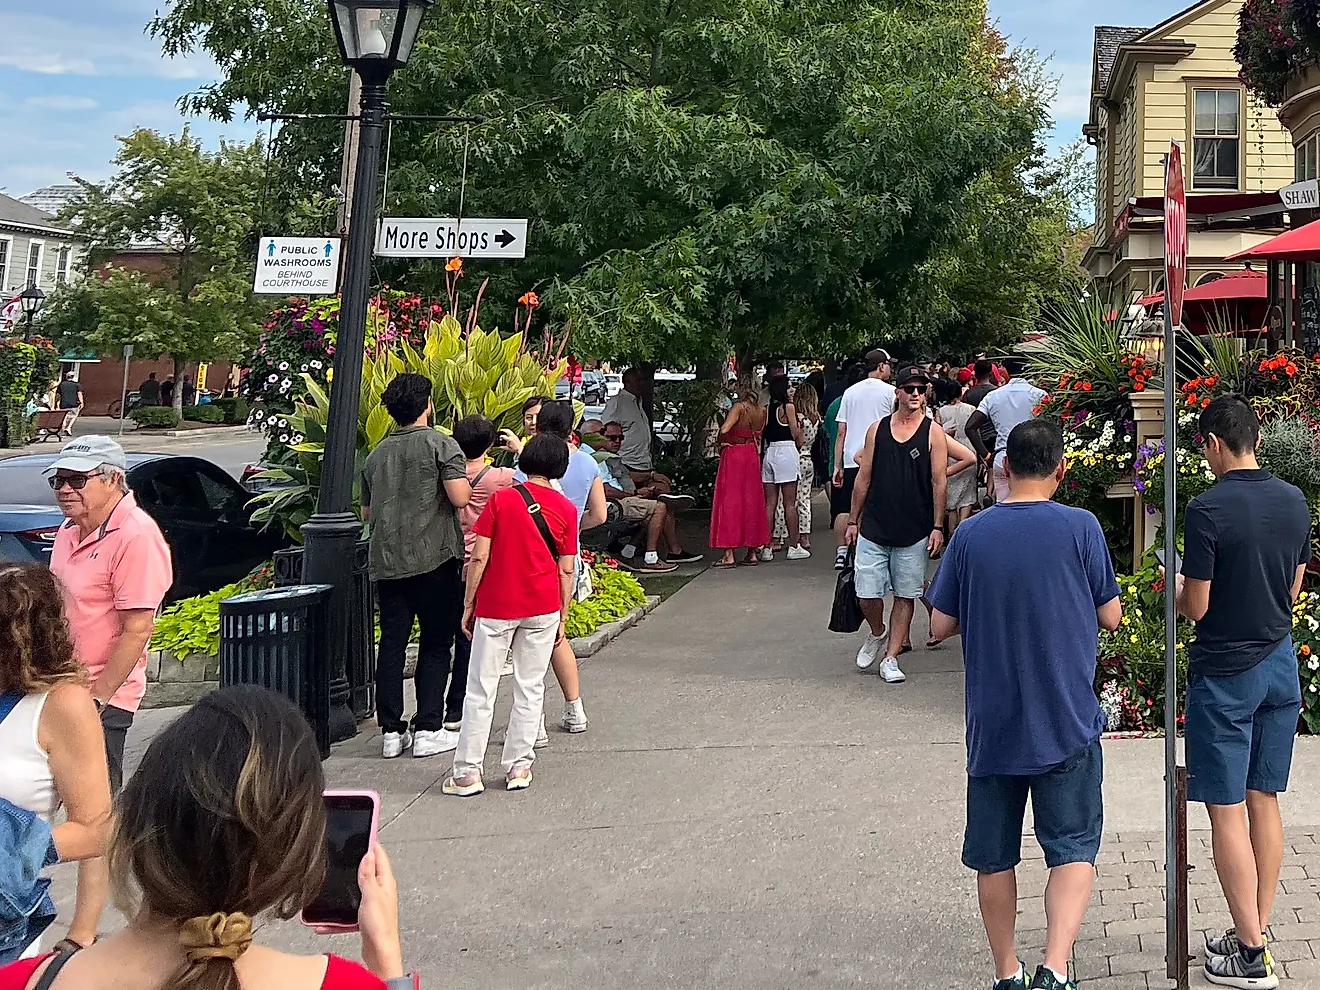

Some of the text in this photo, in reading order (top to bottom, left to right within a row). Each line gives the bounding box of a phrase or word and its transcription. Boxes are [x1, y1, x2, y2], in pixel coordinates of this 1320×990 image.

[1285, 190, 1316, 205] SHAW
[1167, 197, 1184, 268] STOP
[384, 226, 488, 255] More Shops
[281, 246, 318, 255] PUBLIC
[264, 259, 332, 267] WASHROOMS
[277, 271, 313, 279] BEHIND
[262, 279, 329, 287] COURTHOUSE
